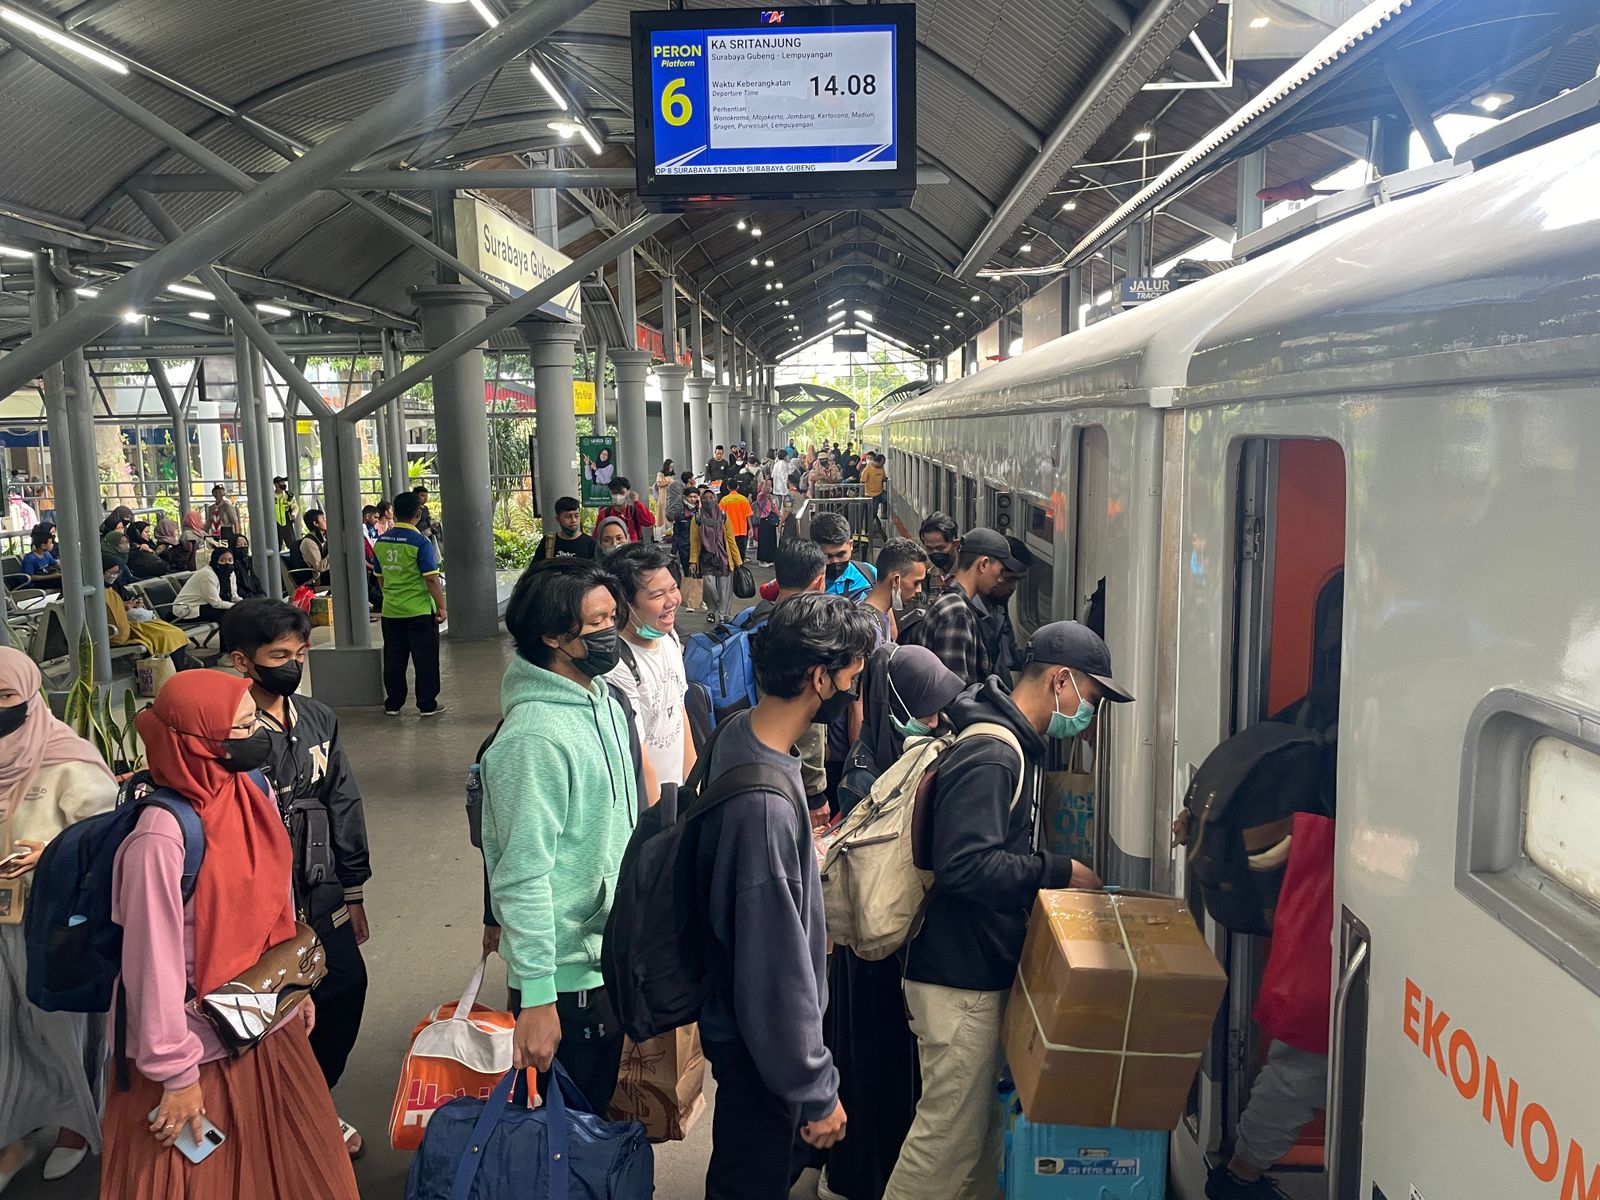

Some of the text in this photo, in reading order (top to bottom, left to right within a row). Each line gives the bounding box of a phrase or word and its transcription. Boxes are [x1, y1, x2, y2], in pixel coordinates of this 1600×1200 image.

[711, 37, 801, 50] KA SRITANJUNG
[653, 44, 702, 58] PERON
[711, 53, 745, 61] Surabaya
[747, 52, 775, 60] Gubeng
[782, 51, 833, 60] Lempuyangan
[712, 80, 791, 88] Waktu Keberangkatan
[810, 74, 876, 96] 14.08
[661, 78, 692, 127] 6
[771, 121, 814, 129] Lempuyangan
[673, 166, 712, 174] SURABAYA
[713, 165, 745, 173] STASIUN
[746, 164, 785, 173] SURABAYA
[786, 163, 816, 172] GUBENG
[483, 223, 529, 276] Surabaya
[1129, 280, 1170, 291] JALUR
[308, 740, 331, 784] N
